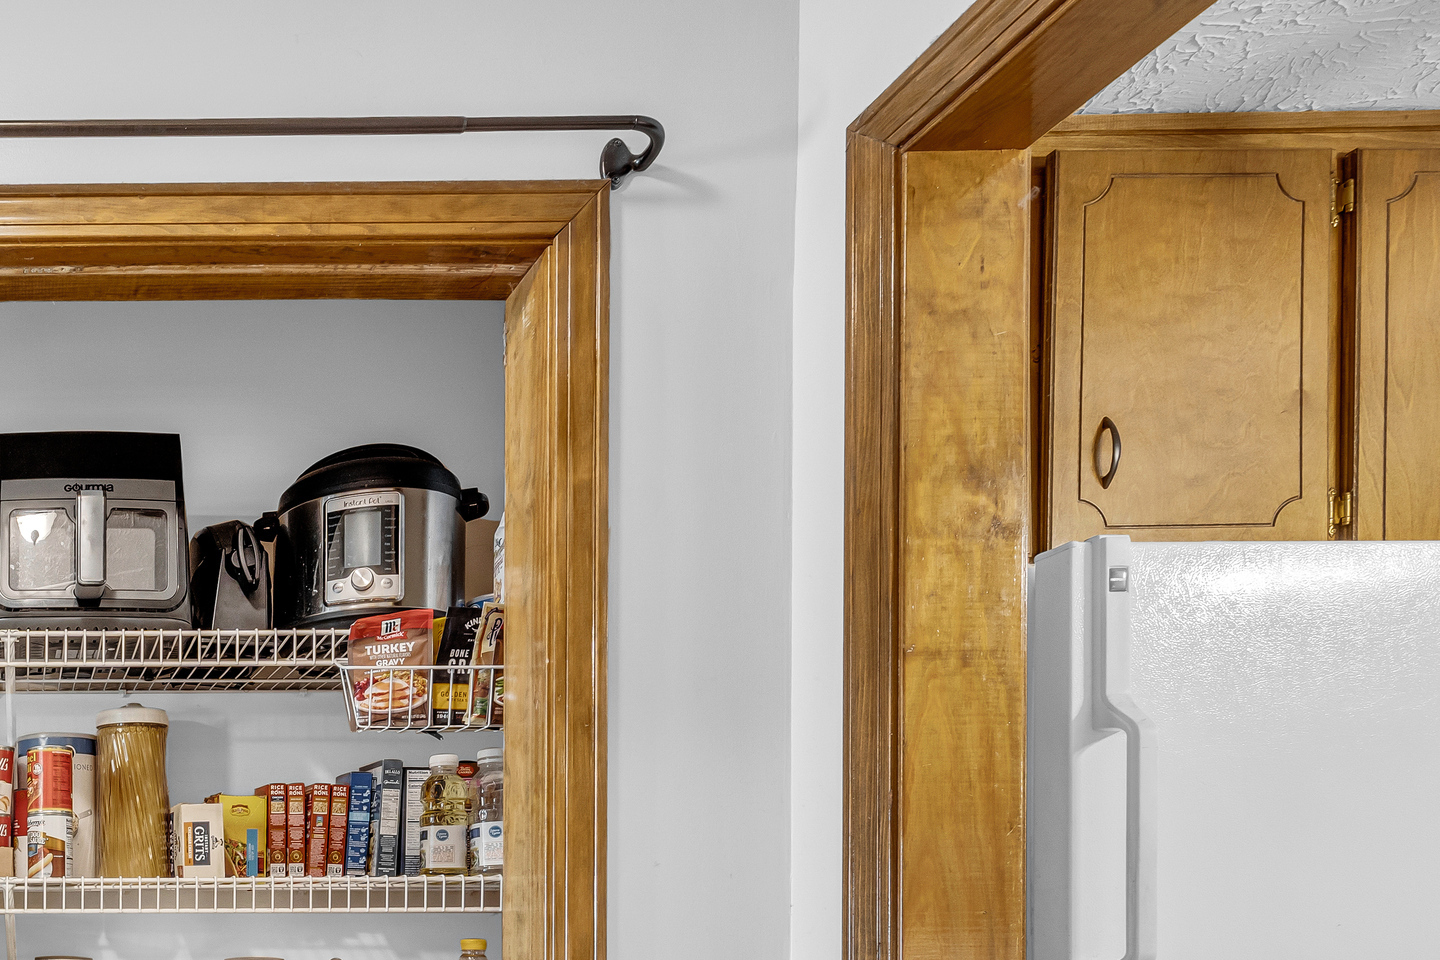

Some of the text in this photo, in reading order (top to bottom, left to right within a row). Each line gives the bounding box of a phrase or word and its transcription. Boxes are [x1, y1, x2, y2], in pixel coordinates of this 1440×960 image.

[376, 631, 405, 641] McCormick
[364, 641, 416, 657] TURKEY
[449, 648, 470, 658] BONE
[375, 657, 406, 667] GRAVY
[193, 825, 206, 862] GRITS
